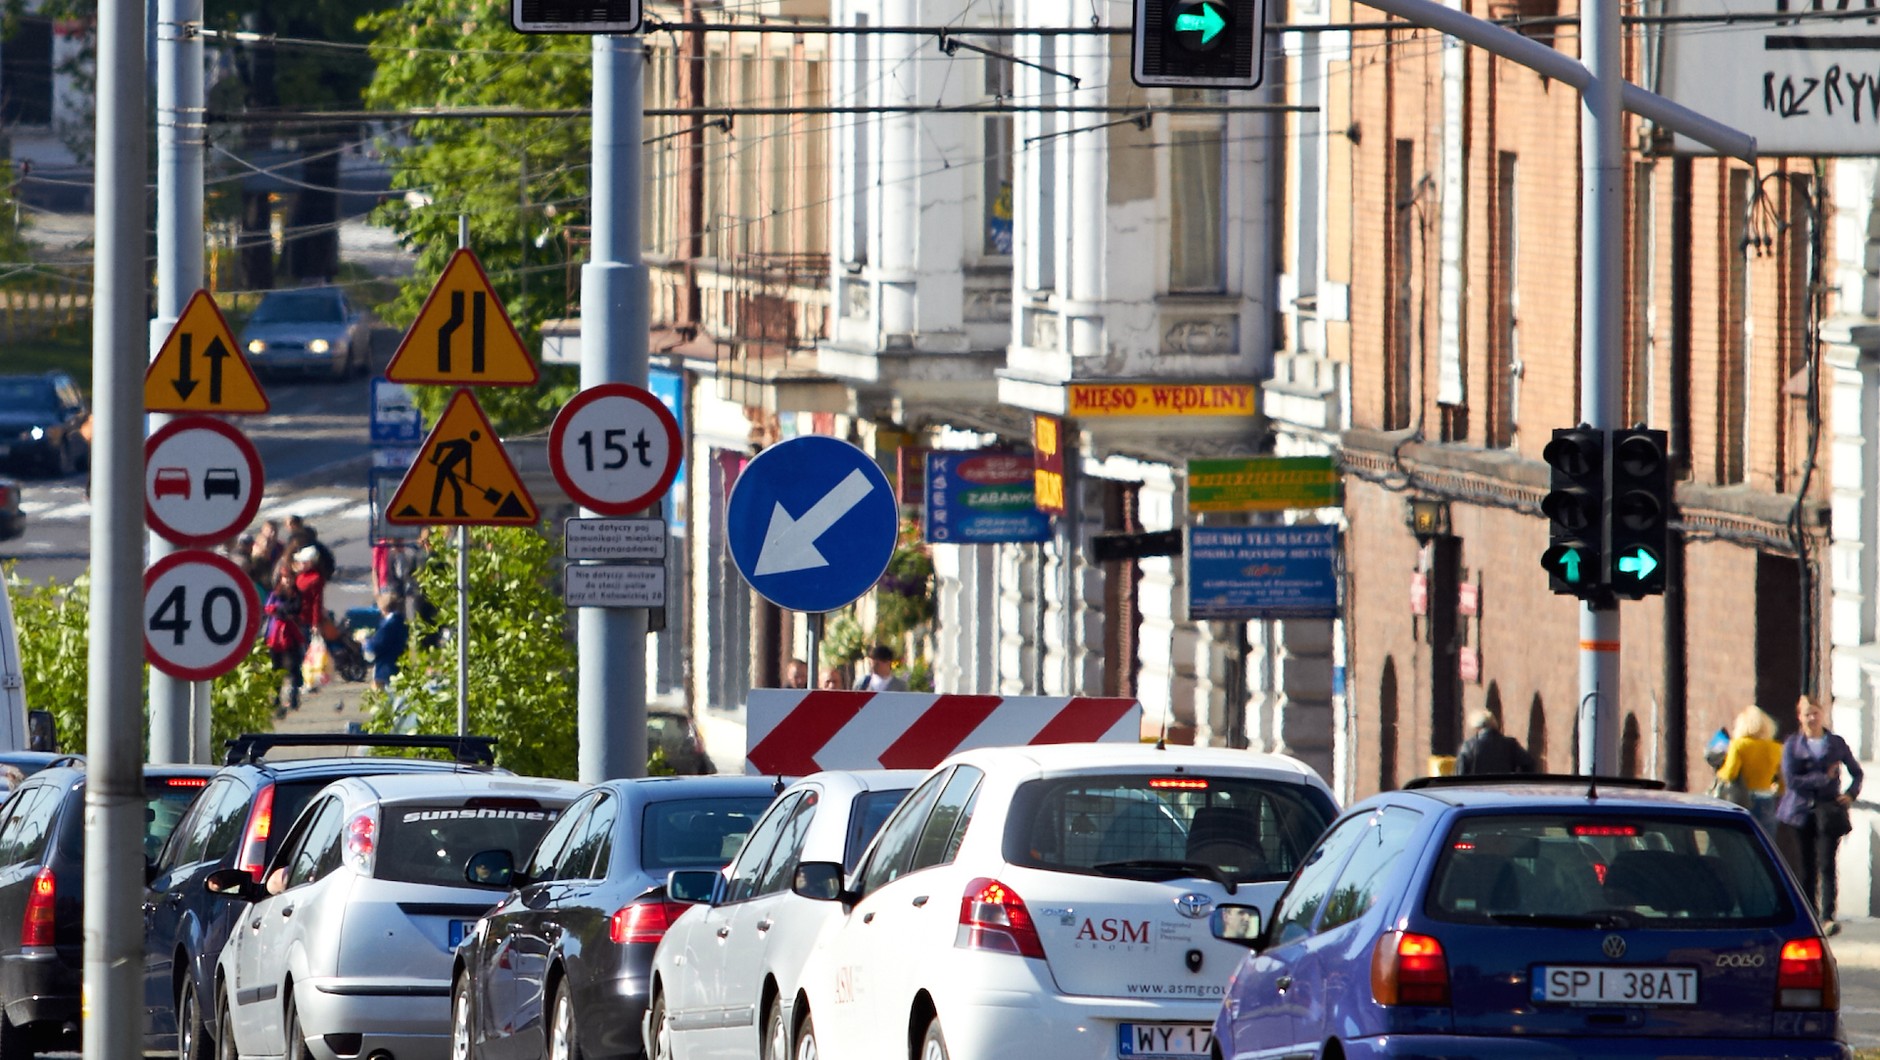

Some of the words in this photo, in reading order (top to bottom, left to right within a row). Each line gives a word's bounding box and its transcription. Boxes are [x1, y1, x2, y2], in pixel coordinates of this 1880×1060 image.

[1074, 387, 1137, 413] MIĘSO
[1152, 386, 1249, 413] WĘDLINY
[578, 427, 652, 472] 15t
[967, 491, 1034, 507] ZABAWK
[580, 523, 595, 531] Nie
[598, 523, 632, 533] dotyczy
[568, 535, 622, 544] komunikacji
[624, 535, 663, 544] miejskiej
[575, 571, 590, 579] Nie
[592, 571, 623, 580] dotyczy
[585, 581, 596, 589] do
[598, 581, 621, 590] stacji
[149, 585, 242, 646] 40
[403, 808, 545, 823] sunshine
[1075, 917, 1151, 944] ASM
[1551, 971, 1605, 998] SPI
[1623, 972, 1693, 1001] 38AT
[1137, 1027, 1174, 1052] WY
